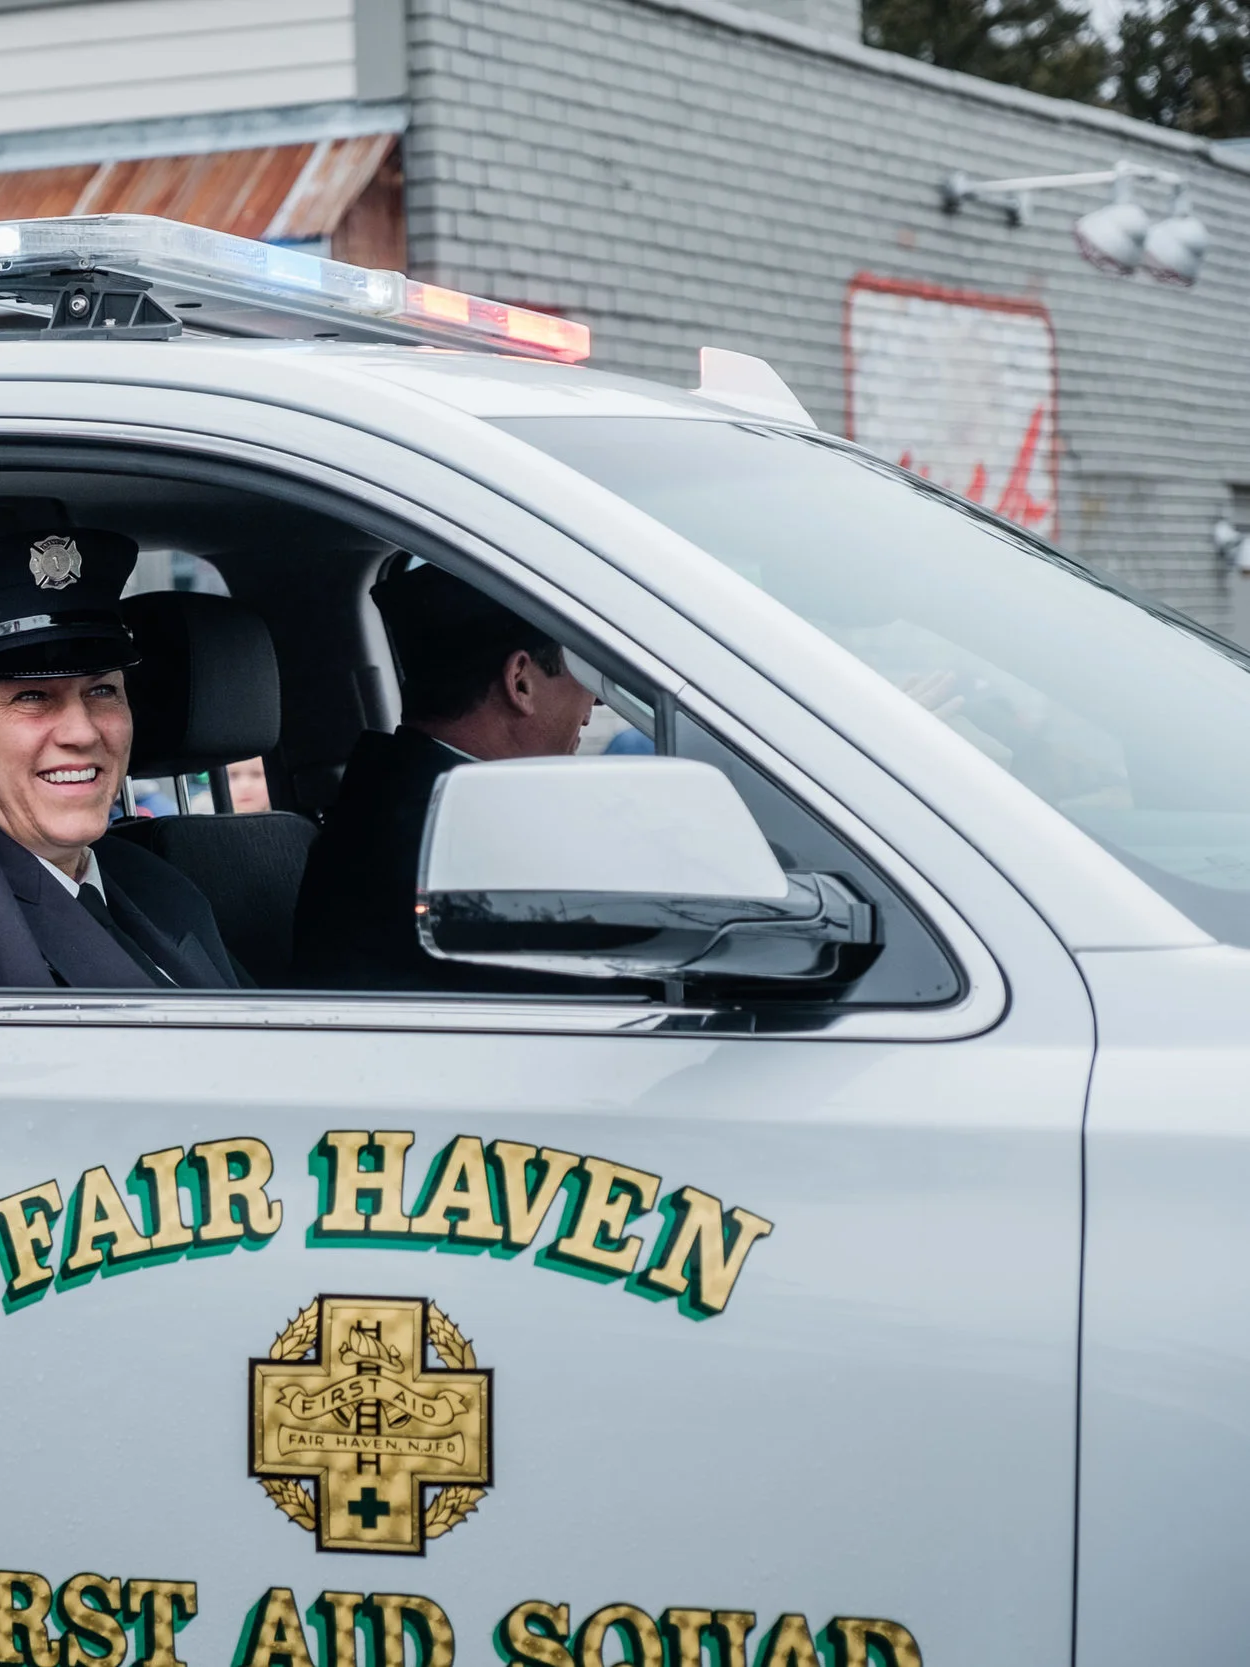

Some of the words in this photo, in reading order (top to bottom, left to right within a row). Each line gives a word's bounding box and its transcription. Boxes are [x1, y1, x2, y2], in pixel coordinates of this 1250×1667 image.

[306, 1129, 774, 1321] HAVEN
[302, 1378, 381, 1414] FIRST
[393, 1391, 436, 1419] AID
[288, 1434, 325, 1447] FAIR
[231, 1586, 455, 1667] AID
[492, 1599, 924, 1667] SQUAD
